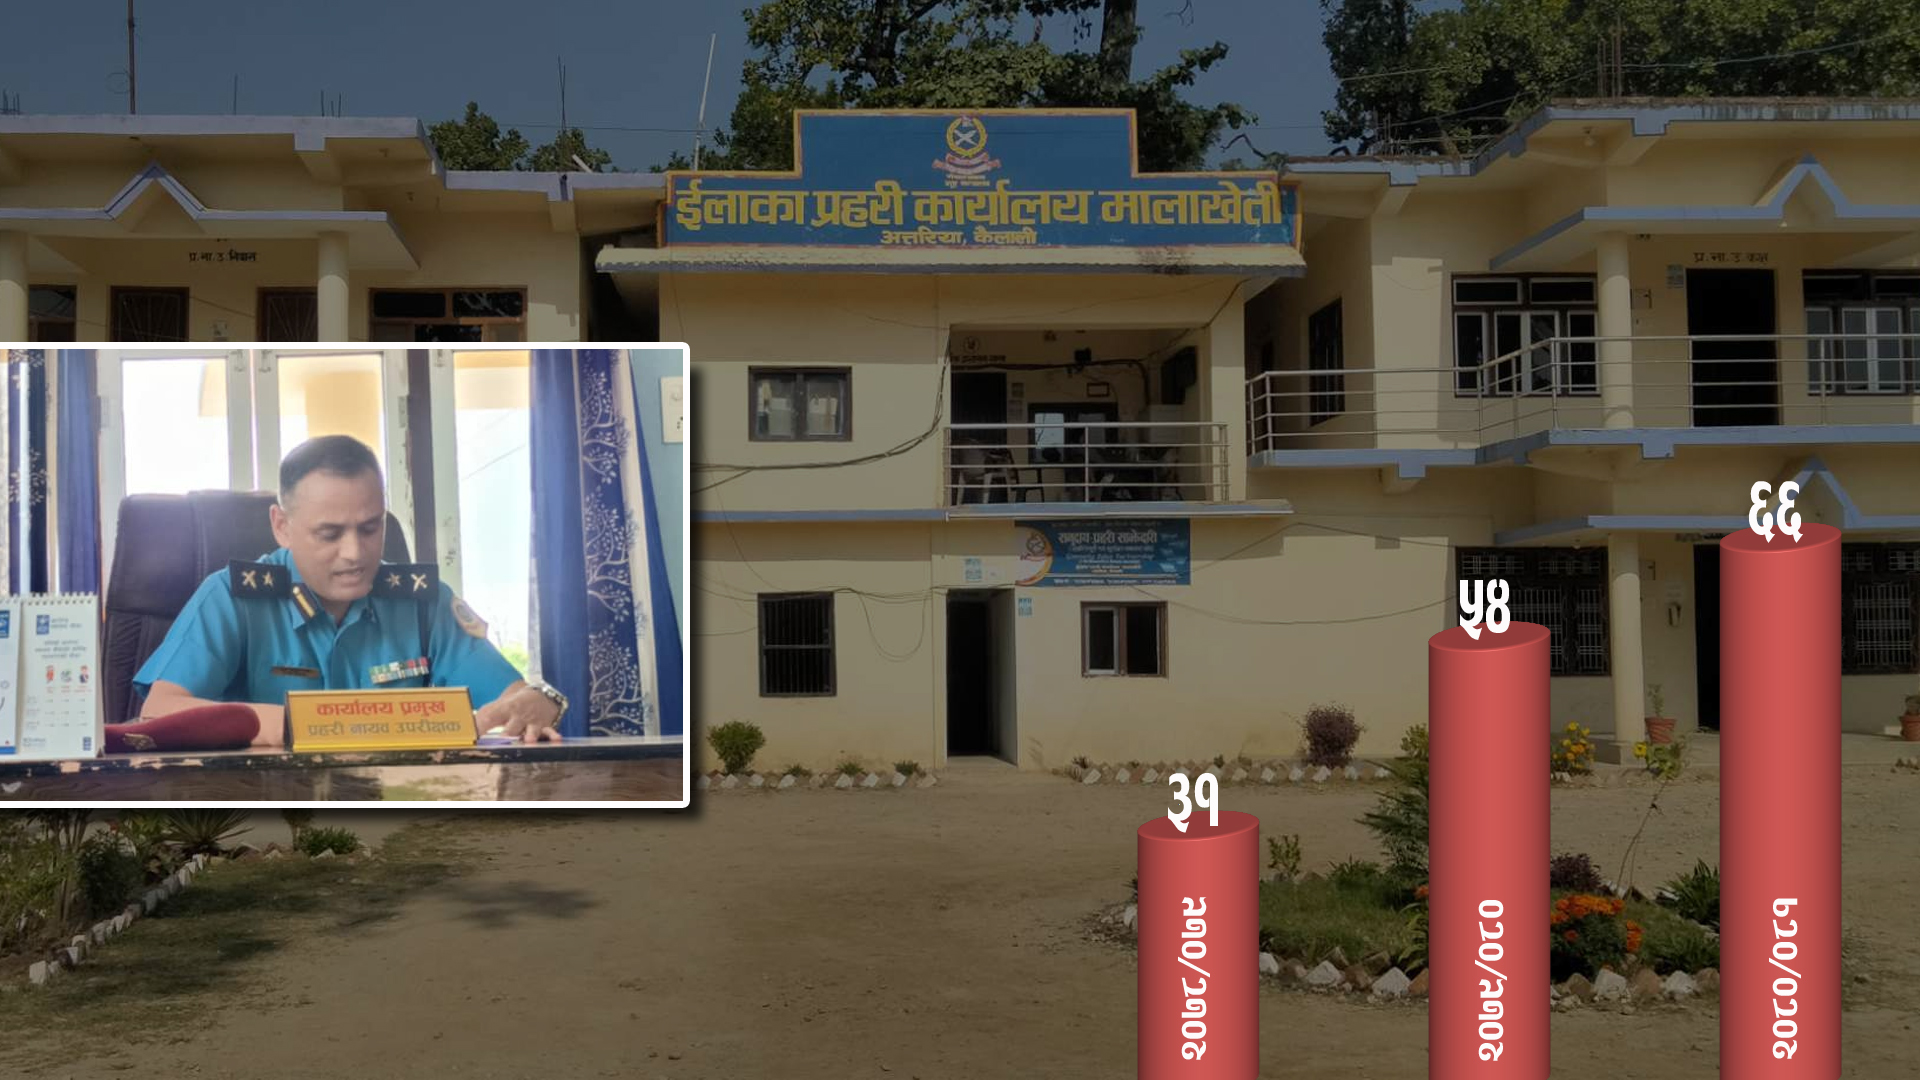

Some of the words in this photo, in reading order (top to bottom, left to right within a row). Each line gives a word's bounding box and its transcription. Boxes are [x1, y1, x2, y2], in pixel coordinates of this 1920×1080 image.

[675, 179, 811, 231] ईलाका
[811, 180, 908, 228] प्रहरी
[910, 179, 1094, 225] कार्यालय
[1098, 180, 1283, 226] मालाखेती
[316, 698, 394, 716] कार्यालय
[400, 699, 446, 717] प्रमुख
[308, 720, 345, 737] प्रहरी
[396, 717, 461, 735] उपरीक्षक
